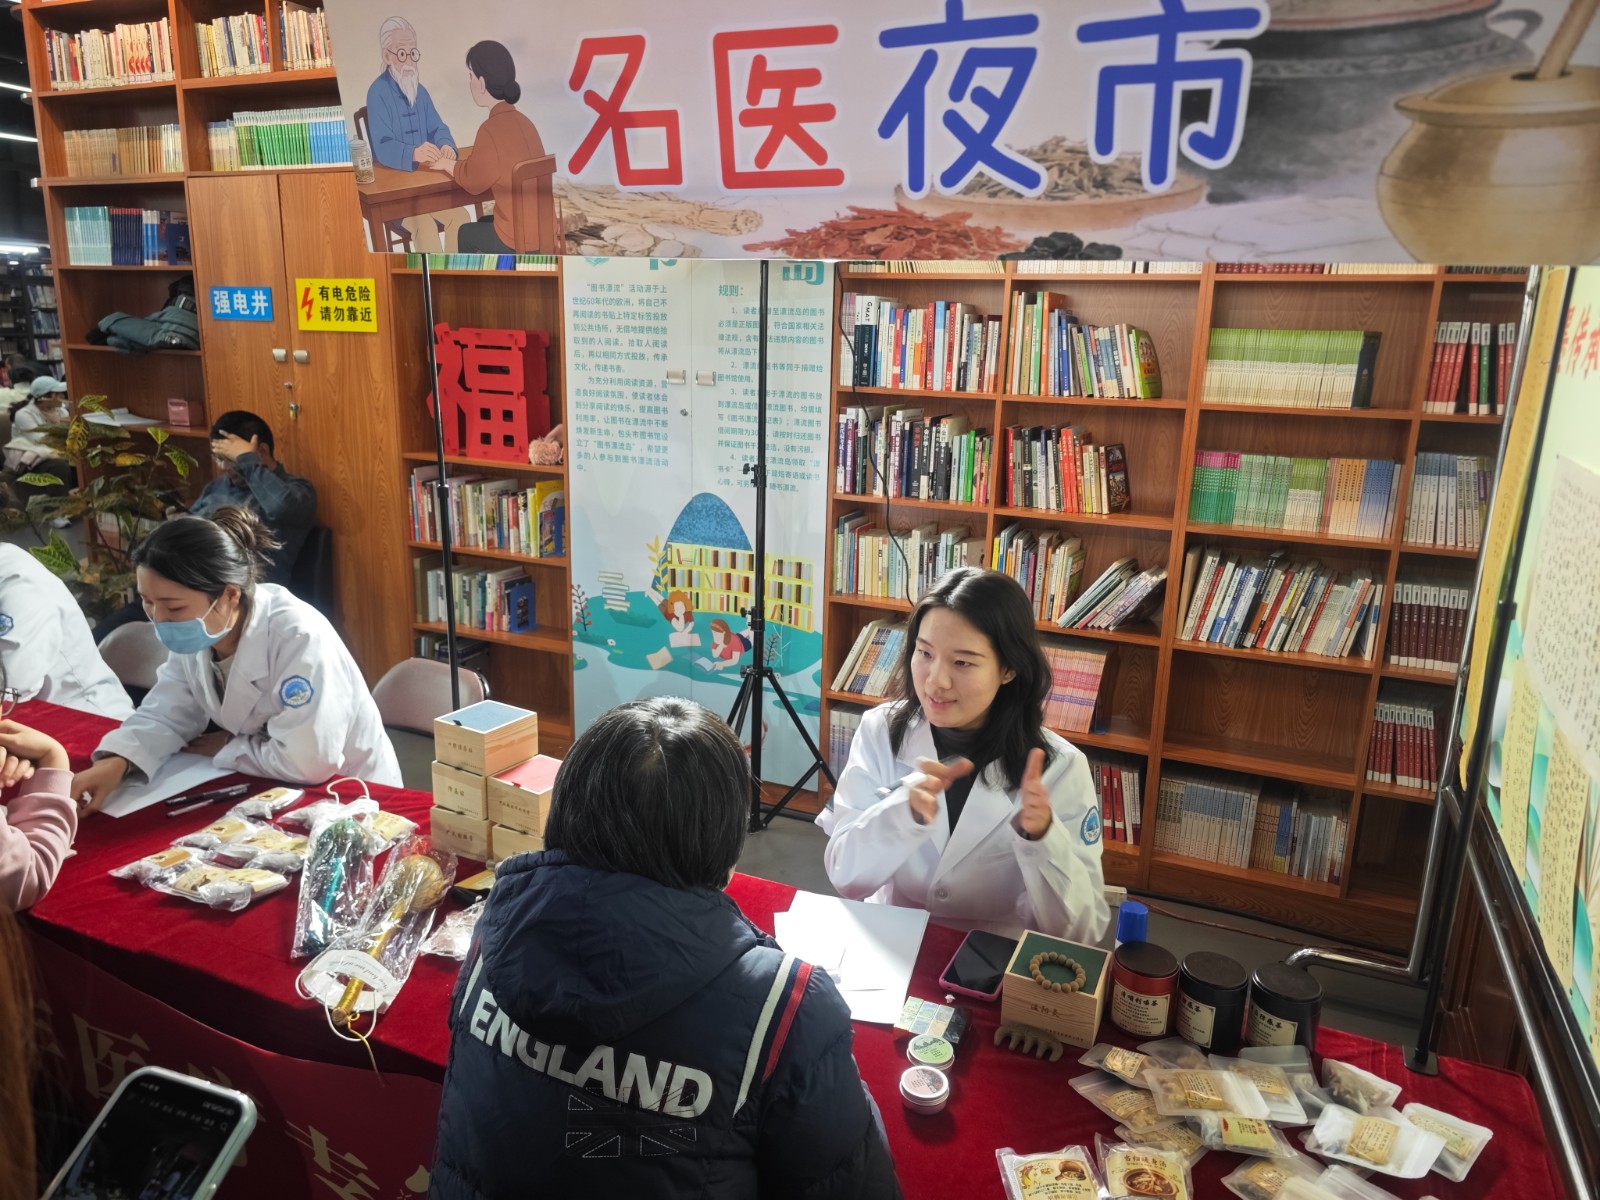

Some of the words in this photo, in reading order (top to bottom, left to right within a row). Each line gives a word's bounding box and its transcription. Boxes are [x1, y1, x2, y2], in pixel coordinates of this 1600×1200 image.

[567, 0, 1263, 193] 名医夜市
[213, 290, 269, 316] 强电井
[318, 285, 371, 302] 有电危险
[320, 306, 373, 322] 请勿靠近
[426, 322, 530, 464] 福
[469, 988, 713, 1118] ENGLAND
